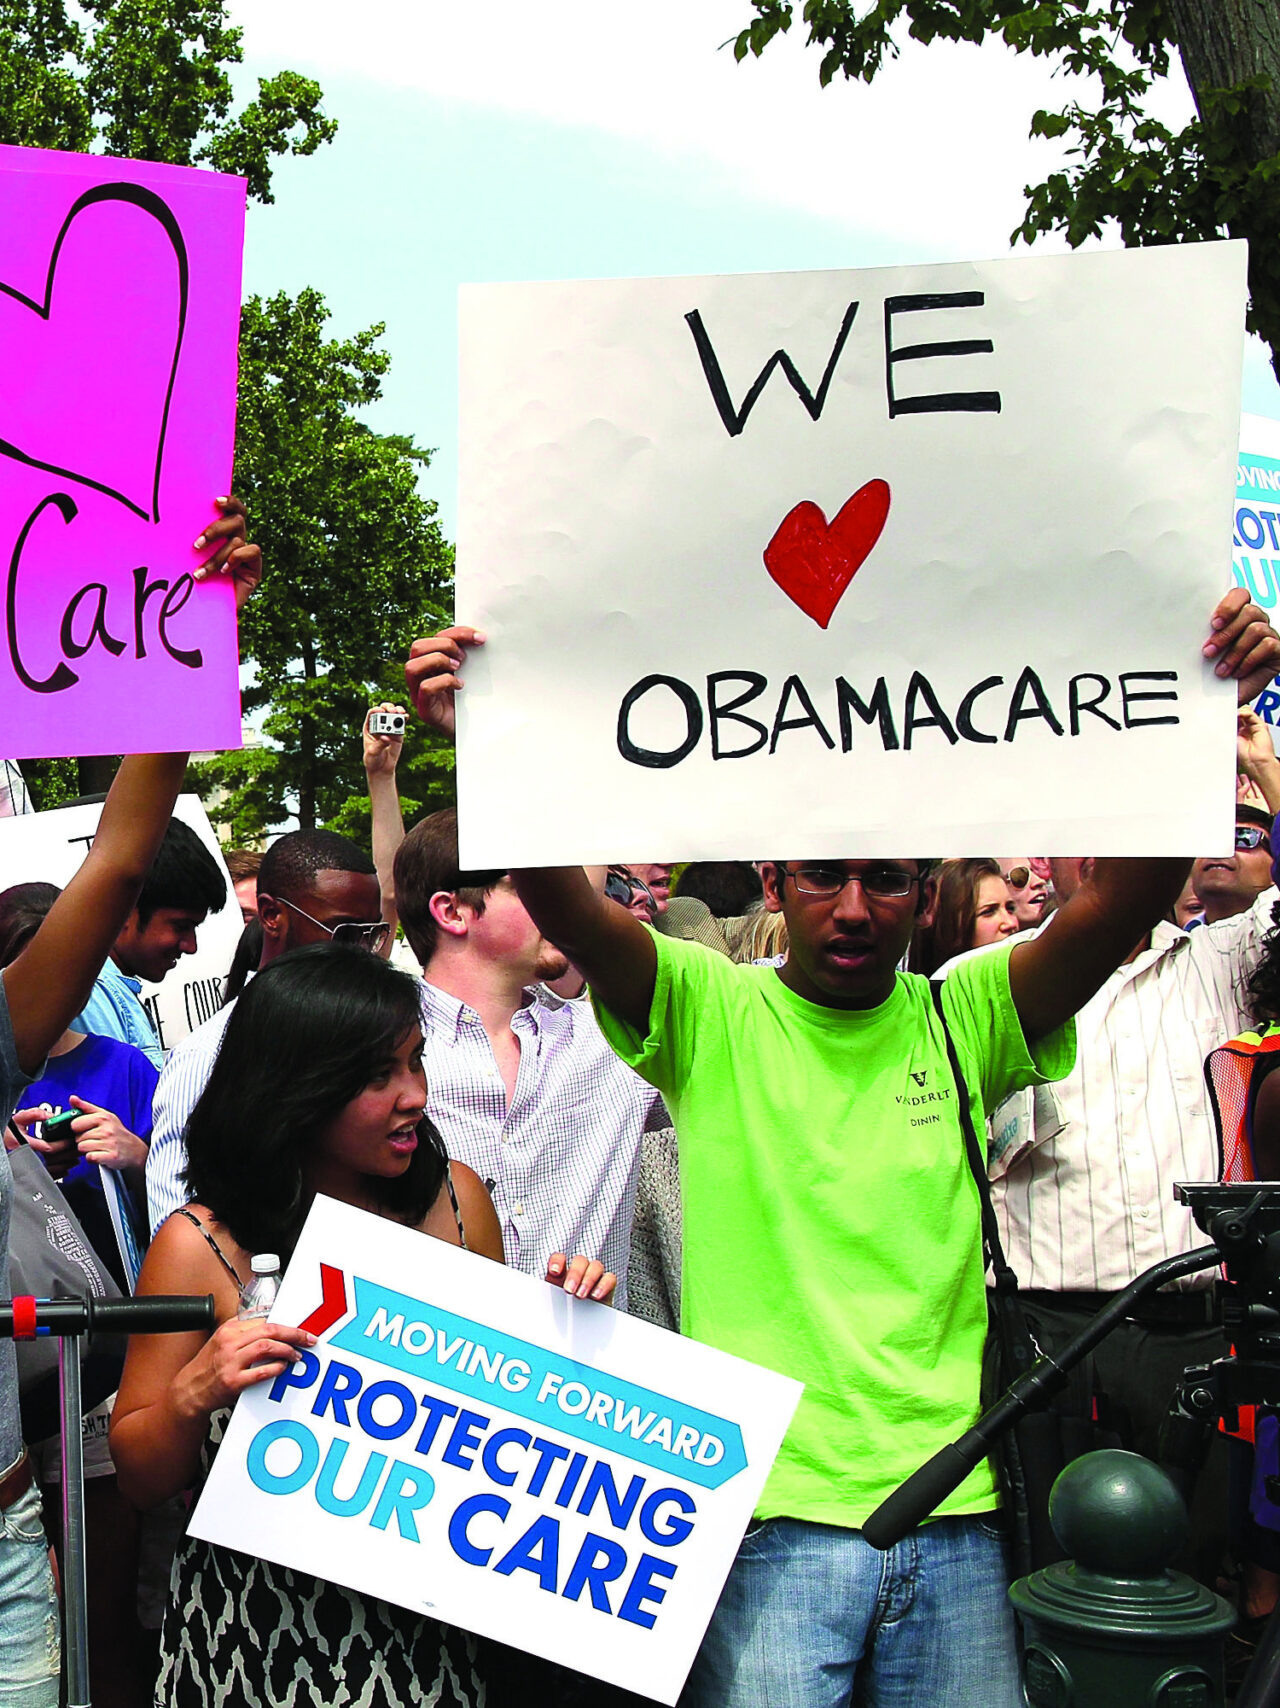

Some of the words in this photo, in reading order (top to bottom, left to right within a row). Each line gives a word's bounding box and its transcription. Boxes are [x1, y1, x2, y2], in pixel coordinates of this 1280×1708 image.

[683, 291, 1001, 437] WE
[617, 664, 1181, 769] OBAMACARE
[267, 1349, 698, 1548] PROTECTING
[363, 1306, 531, 1393] MOVING
[535, 1373, 725, 1468] FORWARD
[246, 1420, 436, 1544] OUR
[447, 1493, 678, 1630] CARE
